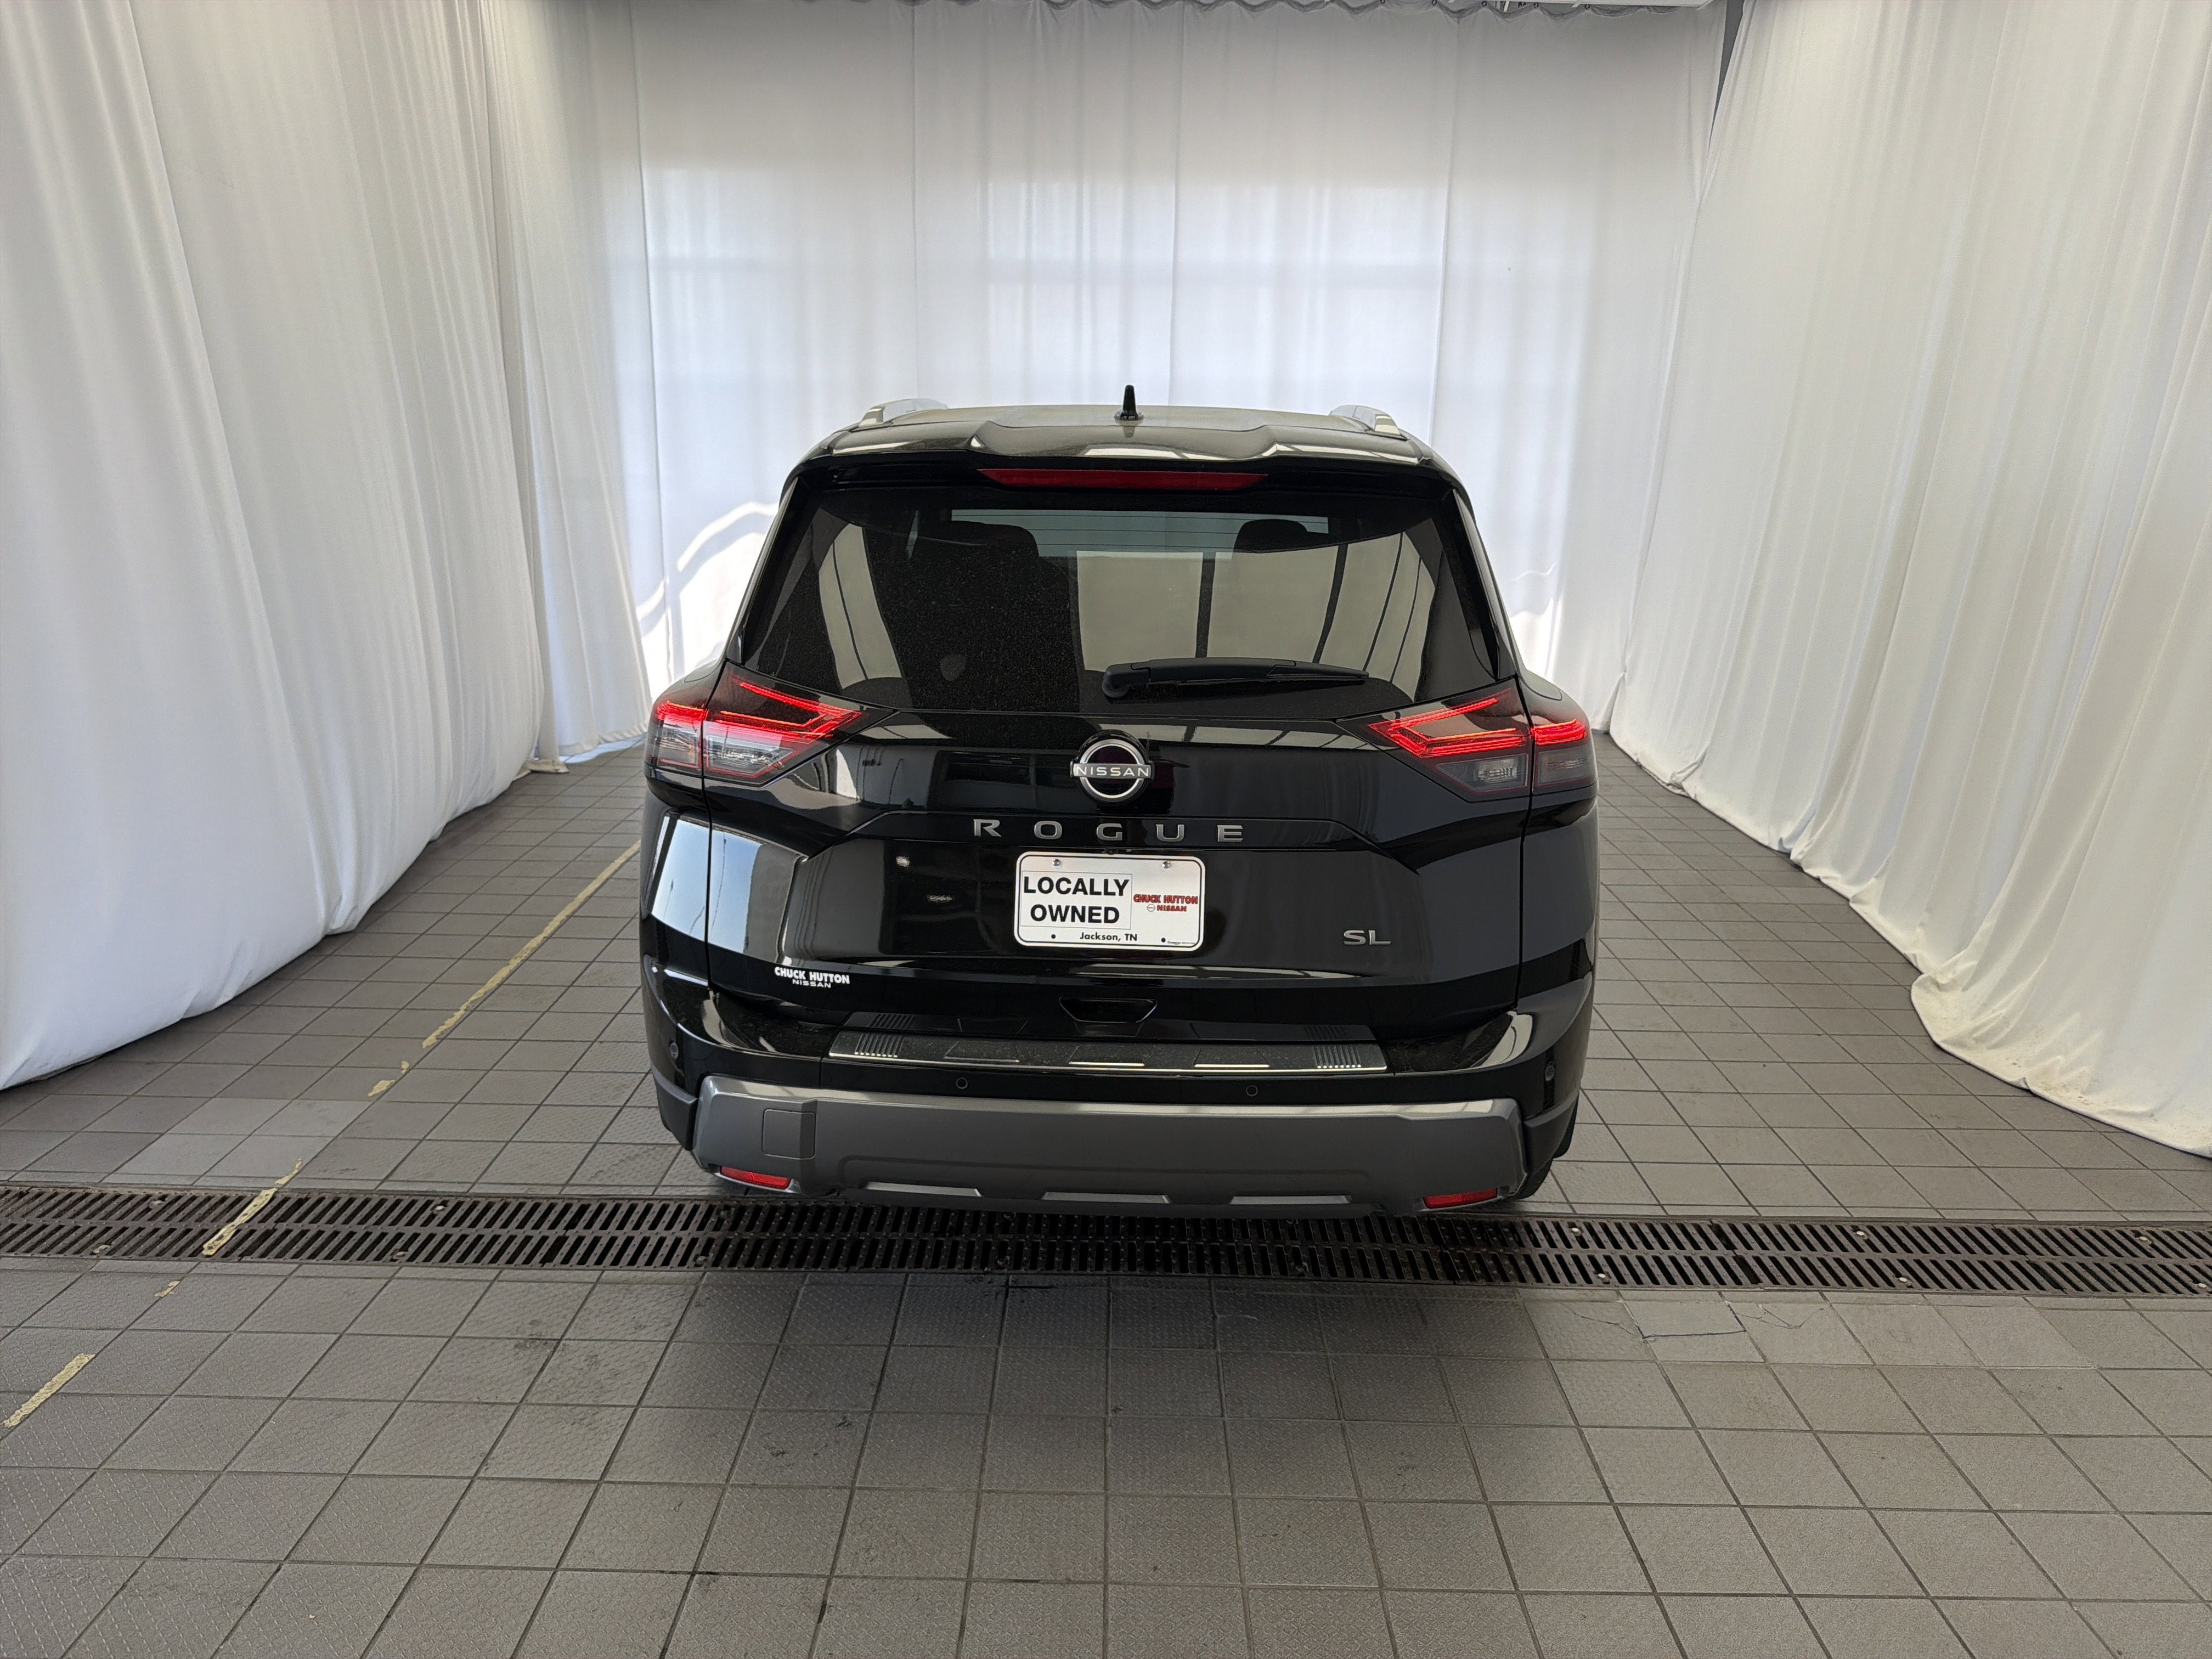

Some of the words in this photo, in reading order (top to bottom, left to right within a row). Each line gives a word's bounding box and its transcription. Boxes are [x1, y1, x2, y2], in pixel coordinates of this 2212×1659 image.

[1076, 766, 1149, 777] NISSAN
[973, 818, 1244, 843] ROGUE
[1024, 876, 1130, 896] LOCALLY
[1133, 894, 1161, 903] CHUCK
[1164, 895, 1198, 904] HUTTON
[1030, 904, 1120, 924] OWNED
[1080, 932, 1121, 942] Jackson,
[1125, 933, 1138, 941] TN
[1343, 930, 1392, 945] SL
[774, 966, 806, 980] CHUCK
[809, 971, 850, 984] HUTTON
[792, 979, 831, 988] NISSAN
